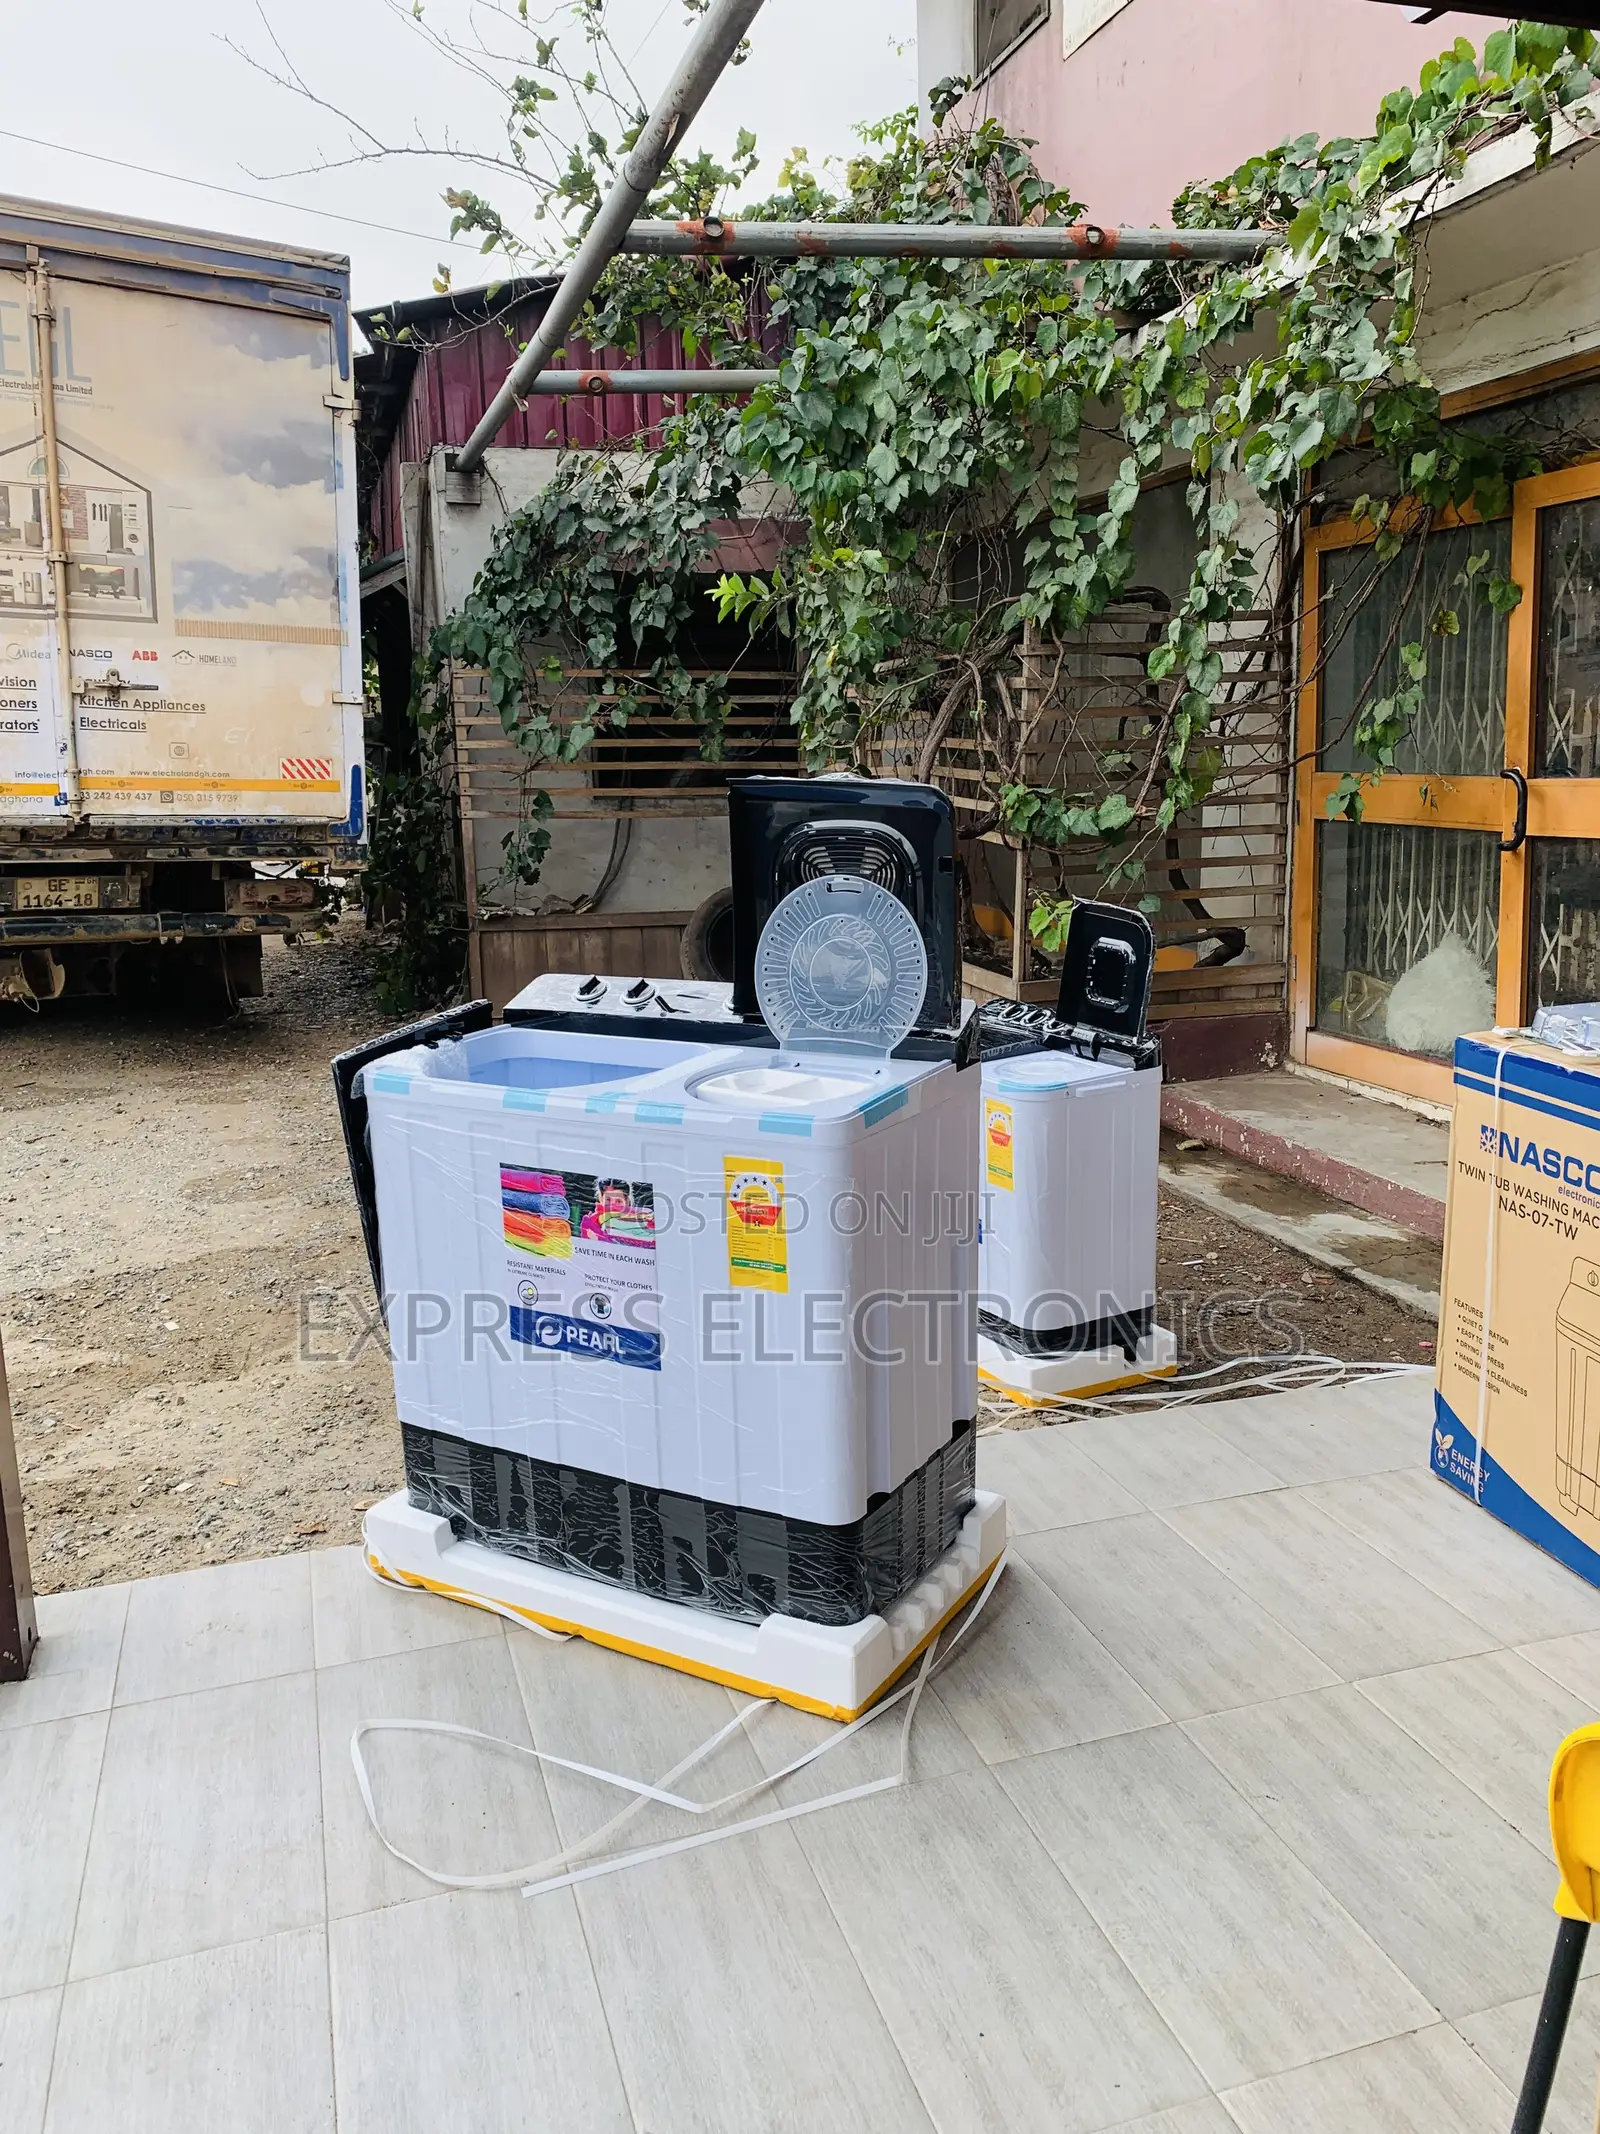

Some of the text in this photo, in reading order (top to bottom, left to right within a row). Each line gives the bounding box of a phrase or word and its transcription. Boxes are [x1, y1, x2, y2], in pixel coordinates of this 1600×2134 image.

[66, 383, 93, 395] Limited
[16, 649, 51, 660] Midea
[69, 649, 113, 659] NASCO
[132, 650, 159, 661] ABB
[199, 654, 237, 664] HOMELAND
[79, 694, 206, 712] Kitchen Appliances
[79, 717, 147, 730] Electricals
[130, 769, 231, 779] www.electrolandgh.com
[94, 792, 111, 800] 242
[114, 792, 131, 801] 439
[135, 792, 152, 801] 437
[176, 793, 238, 803] 050 315 9739
[48, 879, 69, 892] GE
[23, 893, 93, 908] 1164-18
[1458, 1160, 1486, 1183] TWIN
[1488, 1172, 1511, 1192] TUB
[1513, 1182, 1569, 1216] WASHING
[1498, 1194, 1579, 1241] NAS-07-TW
[574, 1246, 591, 1256] SAVE
[591, 1250, 608, 1259] TIME
[616, 1255, 633, 1264] EACH
[634, 1257, 655, 1267] WASH
[506, 1259, 567, 1276] RESISTANT MATERIALS
[584, 1273, 653, 1292] PROTECT YOUR CLOTHES
[1453, 1298, 1484, 1319] FEATURES
[1461, 1327, 1475, 1341] EASY
[1475, 1335, 1483, 1345] TO
[1462, 1315, 1510, 1346] QUIET ORATION
[566, 1326, 626, 1355] PEARL
[1459, 1339, 1479, 1356] DRYING
[1457, 1364, 1480, 1382] MODERN
[1458, 1352, 1474, 1366] HAND
[1490, 1370, 1528, 1398] CLEANLINESS
[1451, 1448, 1491, 1482] ENERGY
[1449, 1461, 1485, 1493] SAVING
